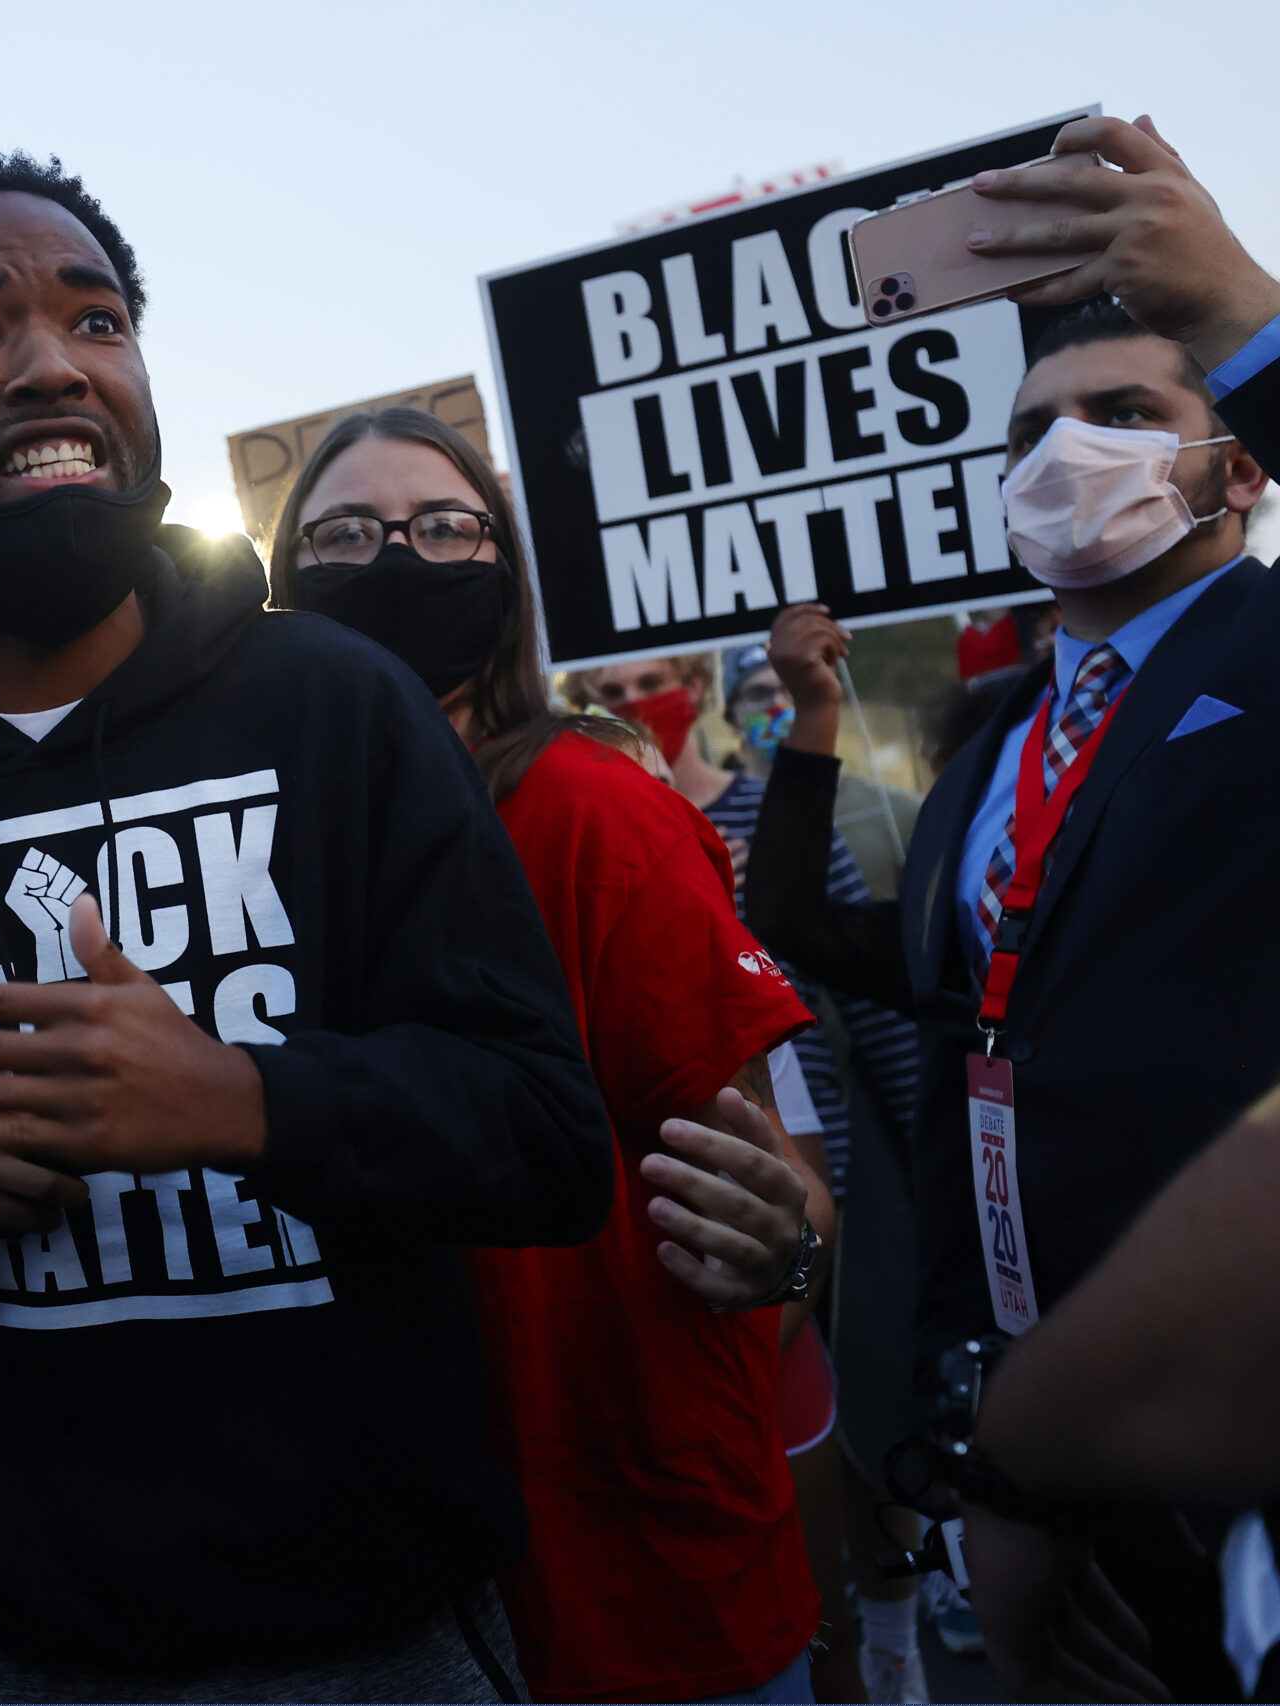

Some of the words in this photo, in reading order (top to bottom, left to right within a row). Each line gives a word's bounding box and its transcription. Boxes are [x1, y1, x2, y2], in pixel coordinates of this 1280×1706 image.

[581, 207, 872, 386] BLAC
[632, 328, 970, 500] LIVES
[980, 1113, 1006, 1135] DEBATE
[982, 1146, 1009, 1208] 20
[988, 1204, 1019, 1267] 20
[1000, 1287, 1030, 1321] UTAH
